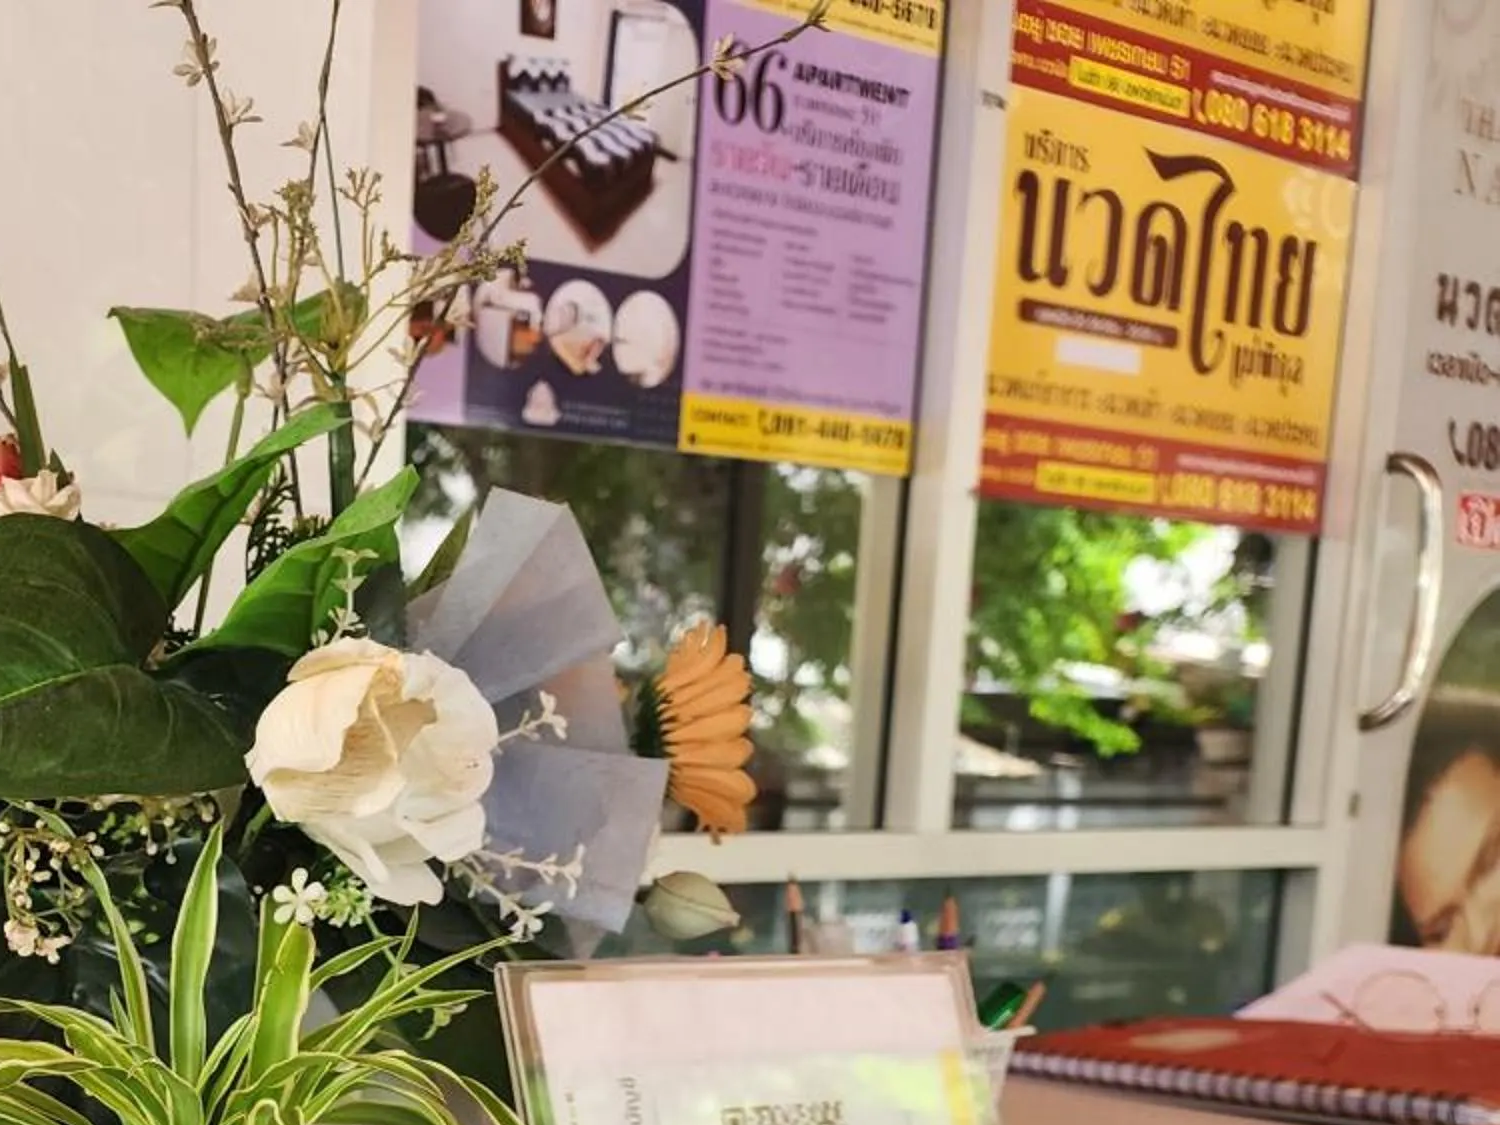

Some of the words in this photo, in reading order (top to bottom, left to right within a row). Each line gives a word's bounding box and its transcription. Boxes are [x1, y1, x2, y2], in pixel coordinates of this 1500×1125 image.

[713, 39, 788, 135] 66
[792, 61, 911, 107] APARTMENT
[1014, 146, 1318, 375] นวดไทย
